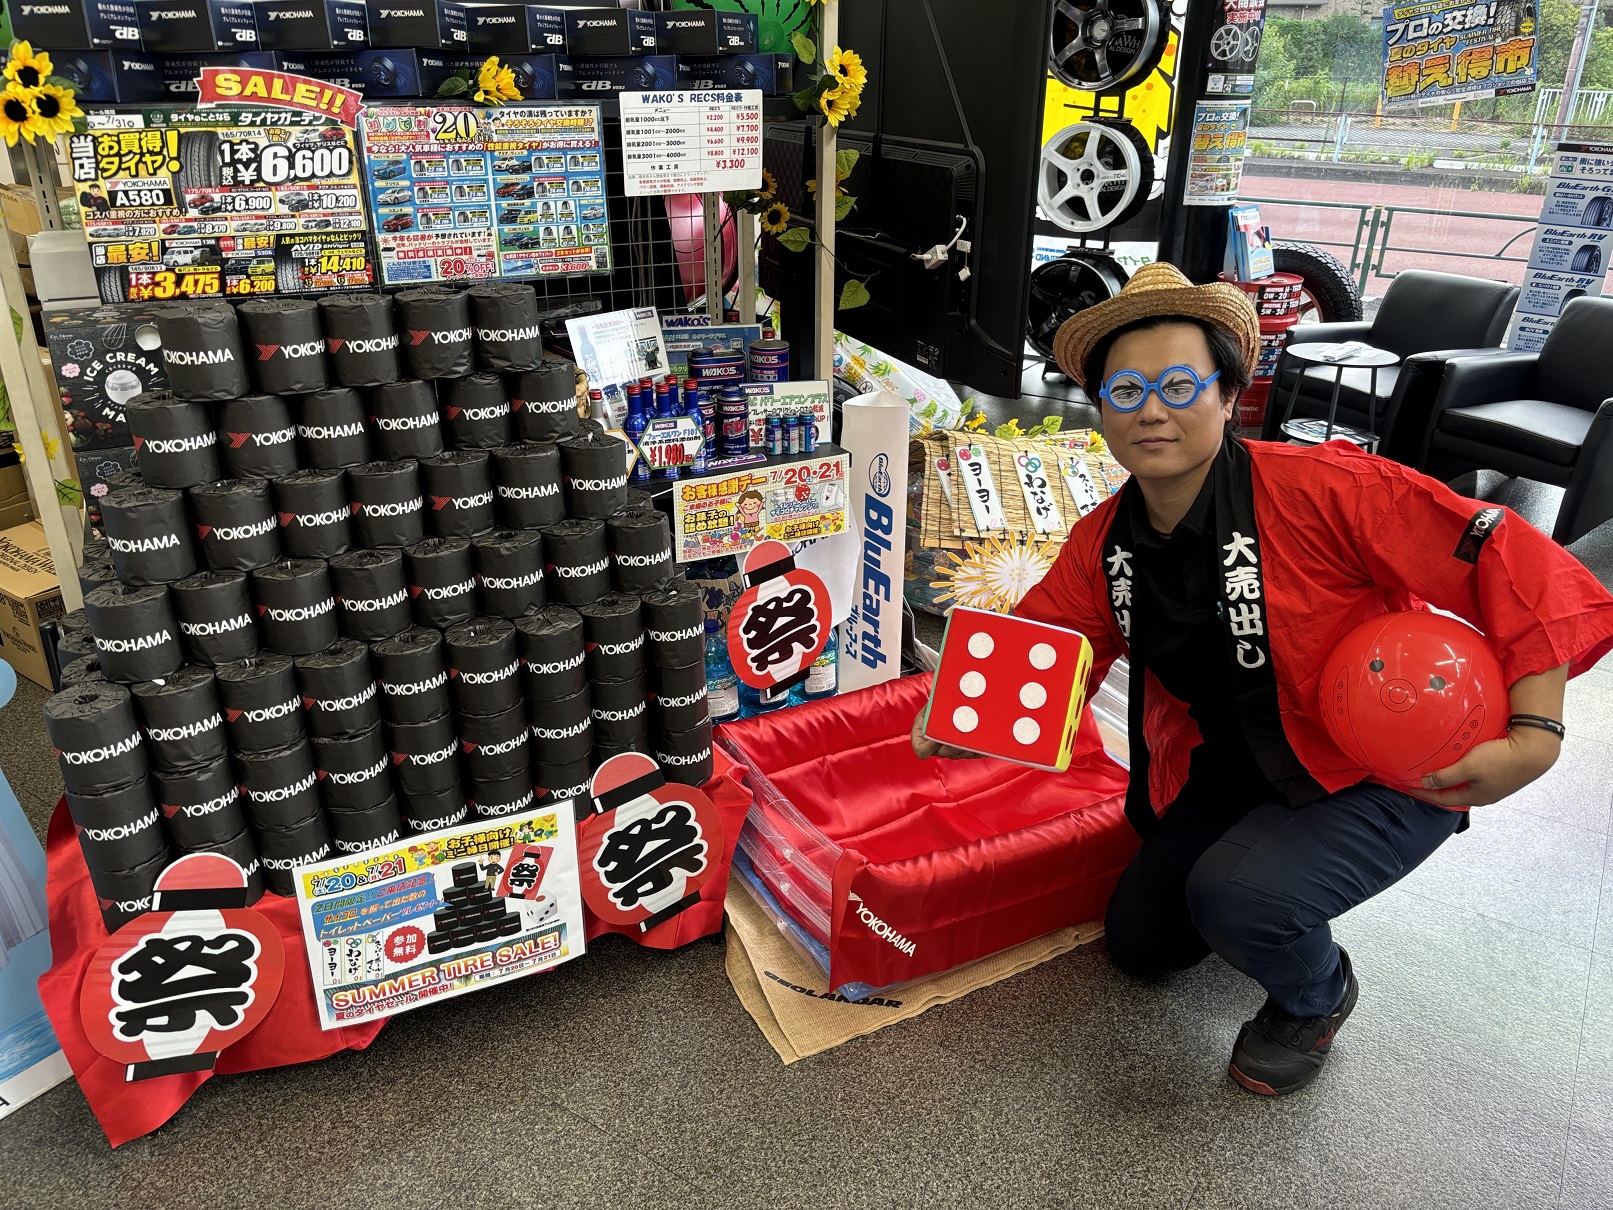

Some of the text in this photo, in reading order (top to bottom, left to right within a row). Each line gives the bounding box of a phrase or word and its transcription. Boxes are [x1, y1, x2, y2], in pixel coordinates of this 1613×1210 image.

[31, 5, 71, 14] YOKOHAMA
[161, 10, 196, 20] YOKOHAMA
[278, 10, 314, 20] YOKOHAMA
[390, 9, 424, 18] YOKOHAMA
[485, 16, 516, 24] YOKOHAMA
[1386, 2, 1498, 46] プロの交換！
[1460, 30, 1488, 40] SUMMER
[1388, 36, 1458, 62] 夏のタイヤ
[1466, 34, 1496, 44] FESTIVAL
[1385, 38, 1535, 98] 替え得市
[214, 73, 346, 114] SALE!!
[642, 92, 743, 104] WAKO'S RECS料金表
[1506, 86, 1532, 94] YOKOHAMA
[170, 113, 231, 122] タイヤのことなら
[498, 109, 593, 119] タイヤの溝は残っていますか？
[97, 130, 163, 156] お買得
[221, 130, 262, 139] 165/70R14
[70, 135, 97, 181] 当店
[220, 141, 255, 163] 1本
[98, 153, 164, 178] タイヤ
[236, 145, 350, 185] ¥6,600
[122, 180, 168, 188] YOKOHAMA
[116, 190, 165, 206] A580
[86, 208, 186, 220] コスパ重視の方におすすめ！
[1542, 228, 1608, 240] BluEarth-RV
[130, 273, 154, 286] 1本
[140, 272, 220, 299] ¥3,475
[1532, 272, 1596, 284] BluEarth-RV
[476, 324, 540, 342] YOKOHAMA
[84, 352, 160, 382] ICE CREAM
[298, 422, 365, 440] YOKOHAMA
[376, 410, 440, 431] YOKOHAMA
[144, 430, 218, 454] YOKOHAMA
[646, 430, 682, 440] フューエルワン
[498, 482, 560, 500] YOKOHAMA
[570, 474, 628, 491] YOKOHAMA
[682, 474, 768, 502] お客様感謝デー
[968, 462, 991, 515] ヨーヨー
[1024, 474, 1054, 520] わなげ
[212, 514, 278, 542] YOKOHAMA
[684, 509, 727, 524] お菓子の
[684, 515, 734, 534] 詰め放題！
[614, 546, 672, 567] YOKOHAMA
[481, 568, 544, 590] YOKOHAMA
[861, 492, 894, 670] BluEarth
[268, 596, 336, 622] YOKOHAMA
[342, 588, 409, 612] YOKOHAMA
[1222, 532, 1266, 669] 大売出し
[178, 612, 253, 636] YOKOHAMA
[743, 588, 818, 672] 祭
[381, 670, 448, 696] YOKOHAMA
[460, 658, 520, 684] YOKOHAMA
[146, 712, 224, 742] YOKOHAMA
[532, 715, 592, 740] YOKOHAMA
[62, 730, 144, 766] YOKOHAMA
[656, 747, 712, 766] YOKOHAMA
[248, 770, 318, 802] YOKOHAMA
[475, 788, 534, 816] YOKOHAMA
[84, 806, 160, 842] YOKOHAMA
[408, 804, 468, 831] YOKOHAMA
[447, 827, 513, 850] お子様向け
[261, 842, 330, 870] YOKOHAMA
[598, 804, 704, 906] 祭
[509, 862, 539, 888] 祭
[320, 911, 401, 938] トイレットペーパー
[324, 908, 358, 924] サイコロ
[393, 934, 417, 946] 参加
[856, 902, 917, 957] YOKOHAMA
[328, 948, 338, 978] ヨーヨー
[346, 948, 362, 976] わなげ
[392, 946, 416, 958] 無料
[333, 931, 560, 1009] SUMMER TIRE SALE!
[116, 934, 256, 1038] 祭
[334, 994, 415, 1021] 夏のタイヤセール
